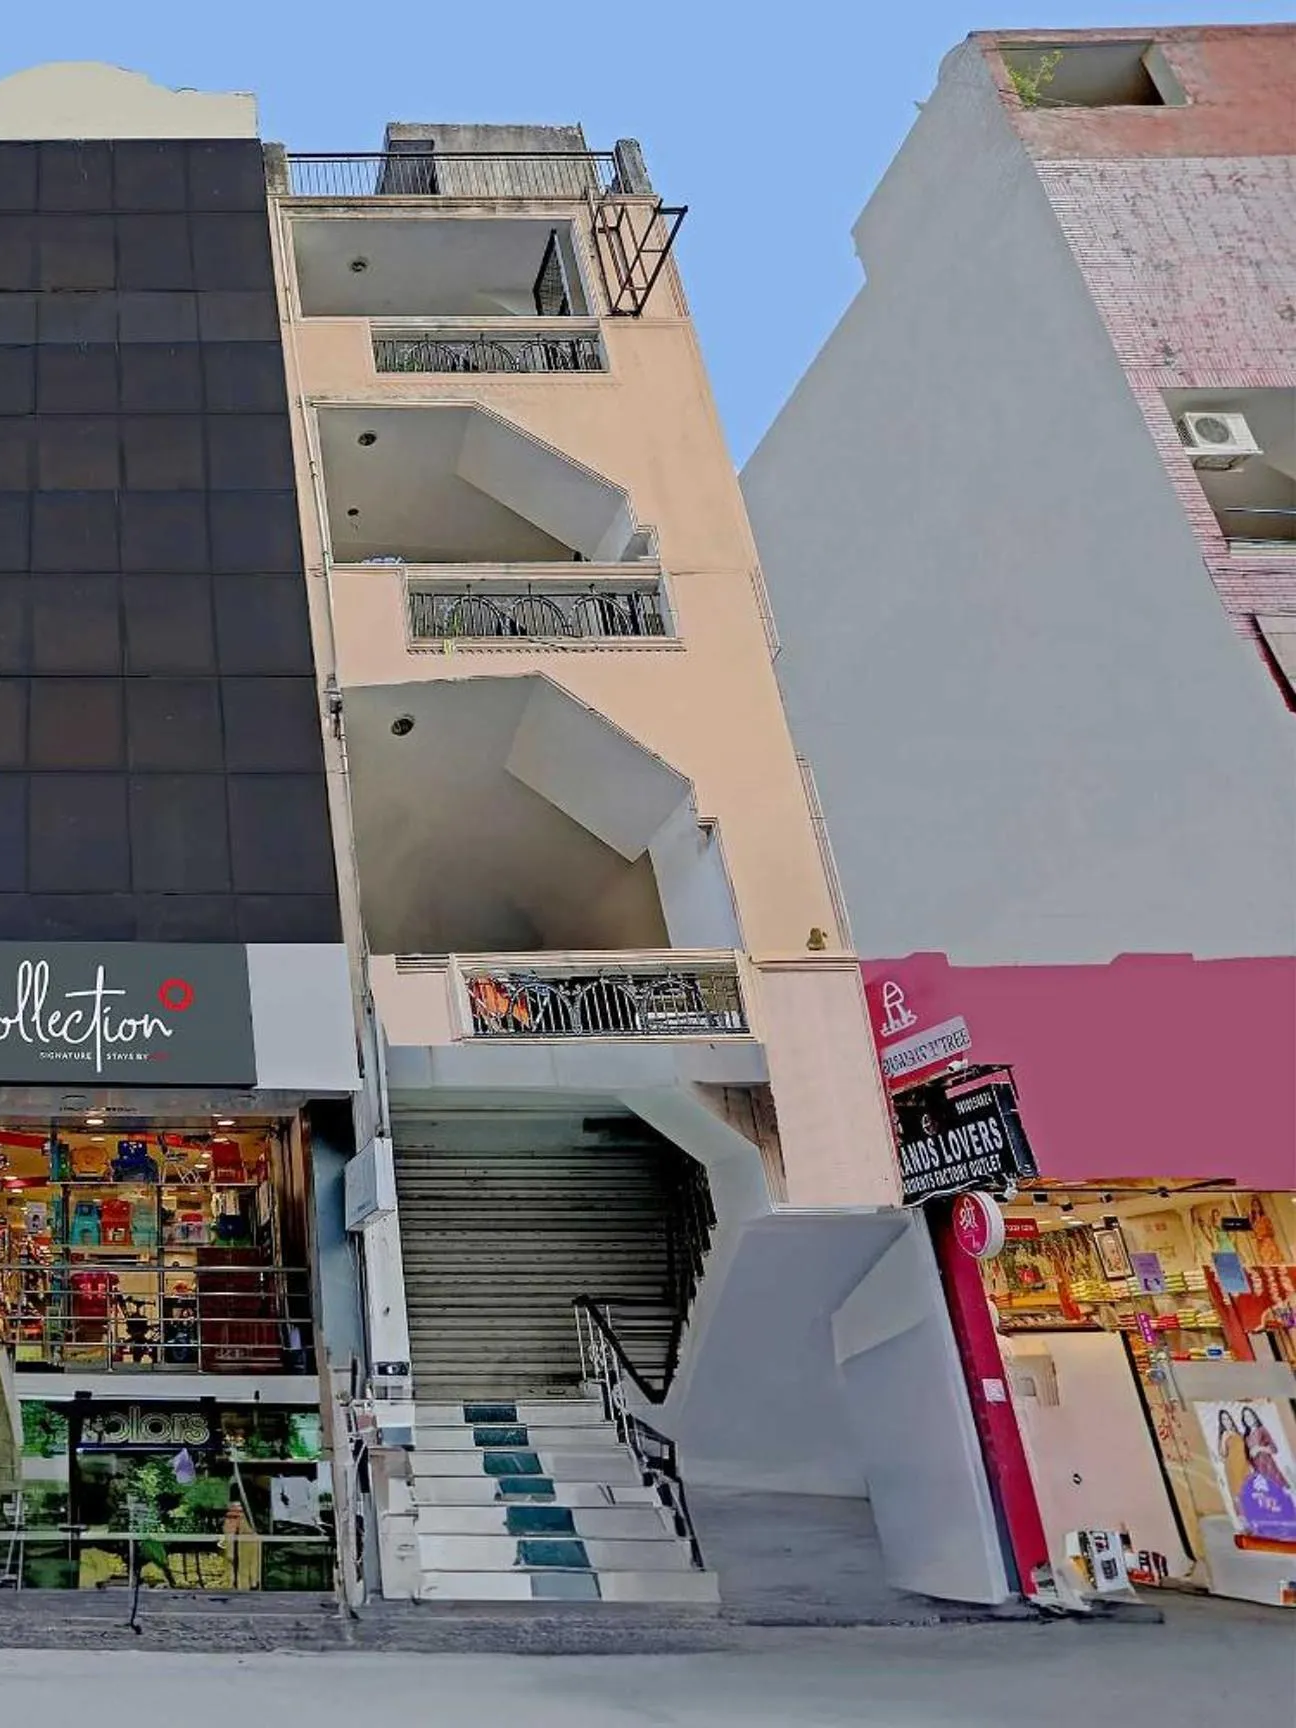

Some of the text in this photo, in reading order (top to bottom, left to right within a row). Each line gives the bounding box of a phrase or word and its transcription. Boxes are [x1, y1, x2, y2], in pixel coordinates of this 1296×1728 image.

[40, 1051, 93, 1061] SIGNATURE
[106, 1052, 134, 1061] STAYS
[900, 1116, 1003, 1177] ANDS LOVERS
[968, 1153, 1002, 1178] OUTLET
